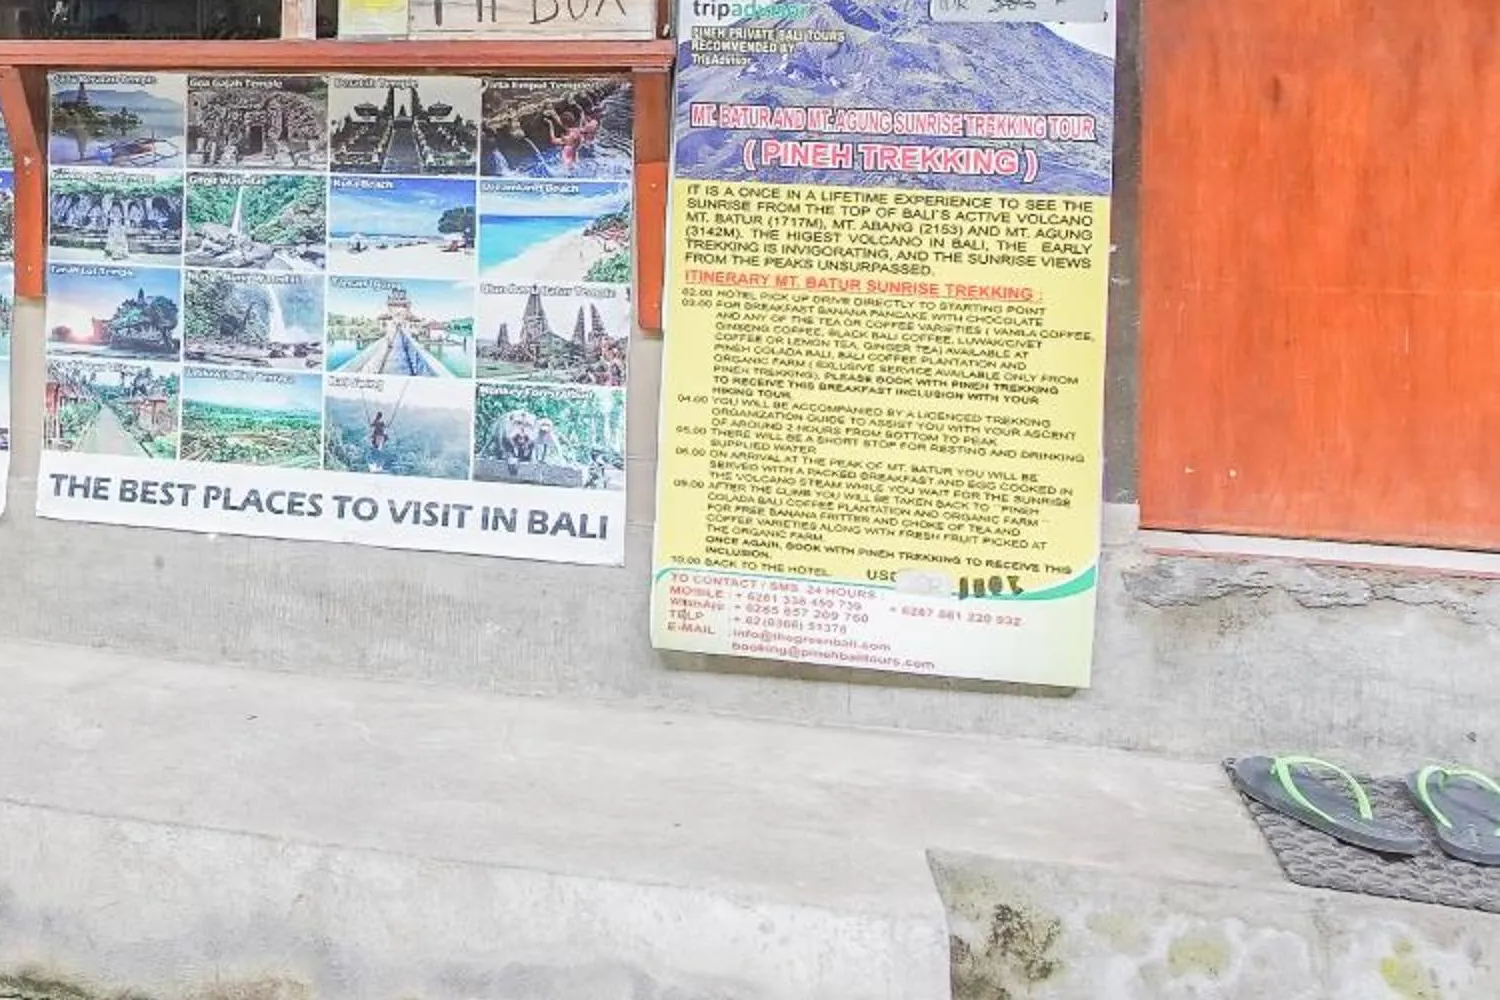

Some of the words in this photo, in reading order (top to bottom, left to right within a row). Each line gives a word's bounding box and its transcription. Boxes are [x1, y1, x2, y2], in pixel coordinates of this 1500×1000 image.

[719, 105, 772, 129] BATUR
[772, 107, 807, 131] AND
[836, 109, 893, 134] AGUNG
[894, 111, 963, 136] SUNRISE
[964, 114, 1046, 139] TREKKING
[1047, 116, 1096, 141] TOUR
[761, 140, 854, 169] PINEH
[857, 143, 1020, 176] TREKKING
[687, 184, 699, 195] IT
[706, 185, 719, 196] IS
[724, 186, 736, 196] A
[739, 187, 780, 199] ONCE
[787, 190, 800, 199] IN
[805, 190, 817, 200] A
[821, 191, 888, 204] LIFETIME
[894, 193, 992, 209] EXPERIENCE
[999, 198, 1019, 209] TO
[1025, 199, 1056, 211] SEE
[1062, 200, 1093, 212] THE
[687, 199, 750, 211] SUNRISE
[757, 202, 800, 213] FROM
[805, 204, 834, 215] THE
[840, 206, 870, 217] TOP
[876, 207, 896, 217] OF
[955, 211, 1010, 223] ACTIVE
[1017, 213, 1093, 226] VOLCANO
[686, 211, 709, 223] MT.
[715, 213, 763, 225] BATUR
[833, 219, 856, 230] MT.
[860, 219, 913, 234] ABANG
[967, 225, 1000, 237] AND
[1006, 227, 1029, 238] MT.
[1035, 228, 1092, 240] AGUNG
[685, 269, 770, 287] ITINERARY
[775, 273, 800, 288] MT.
[805, 276, 860, 291] BATUR
[866, 279, 940, 296] SUNRISE
[944, 283, 1033, 301] TREKKING
[49, 472, 110, 501] THE
[118, 478, 197, 509] BEST
[202, 484, 324, 518] PLACES
[331, 493, 379, 523] TO
[387, 498, 474, 531] VISIT
[480, 506, 517, 534] IN
[526, 509, 609, 541] BALI
